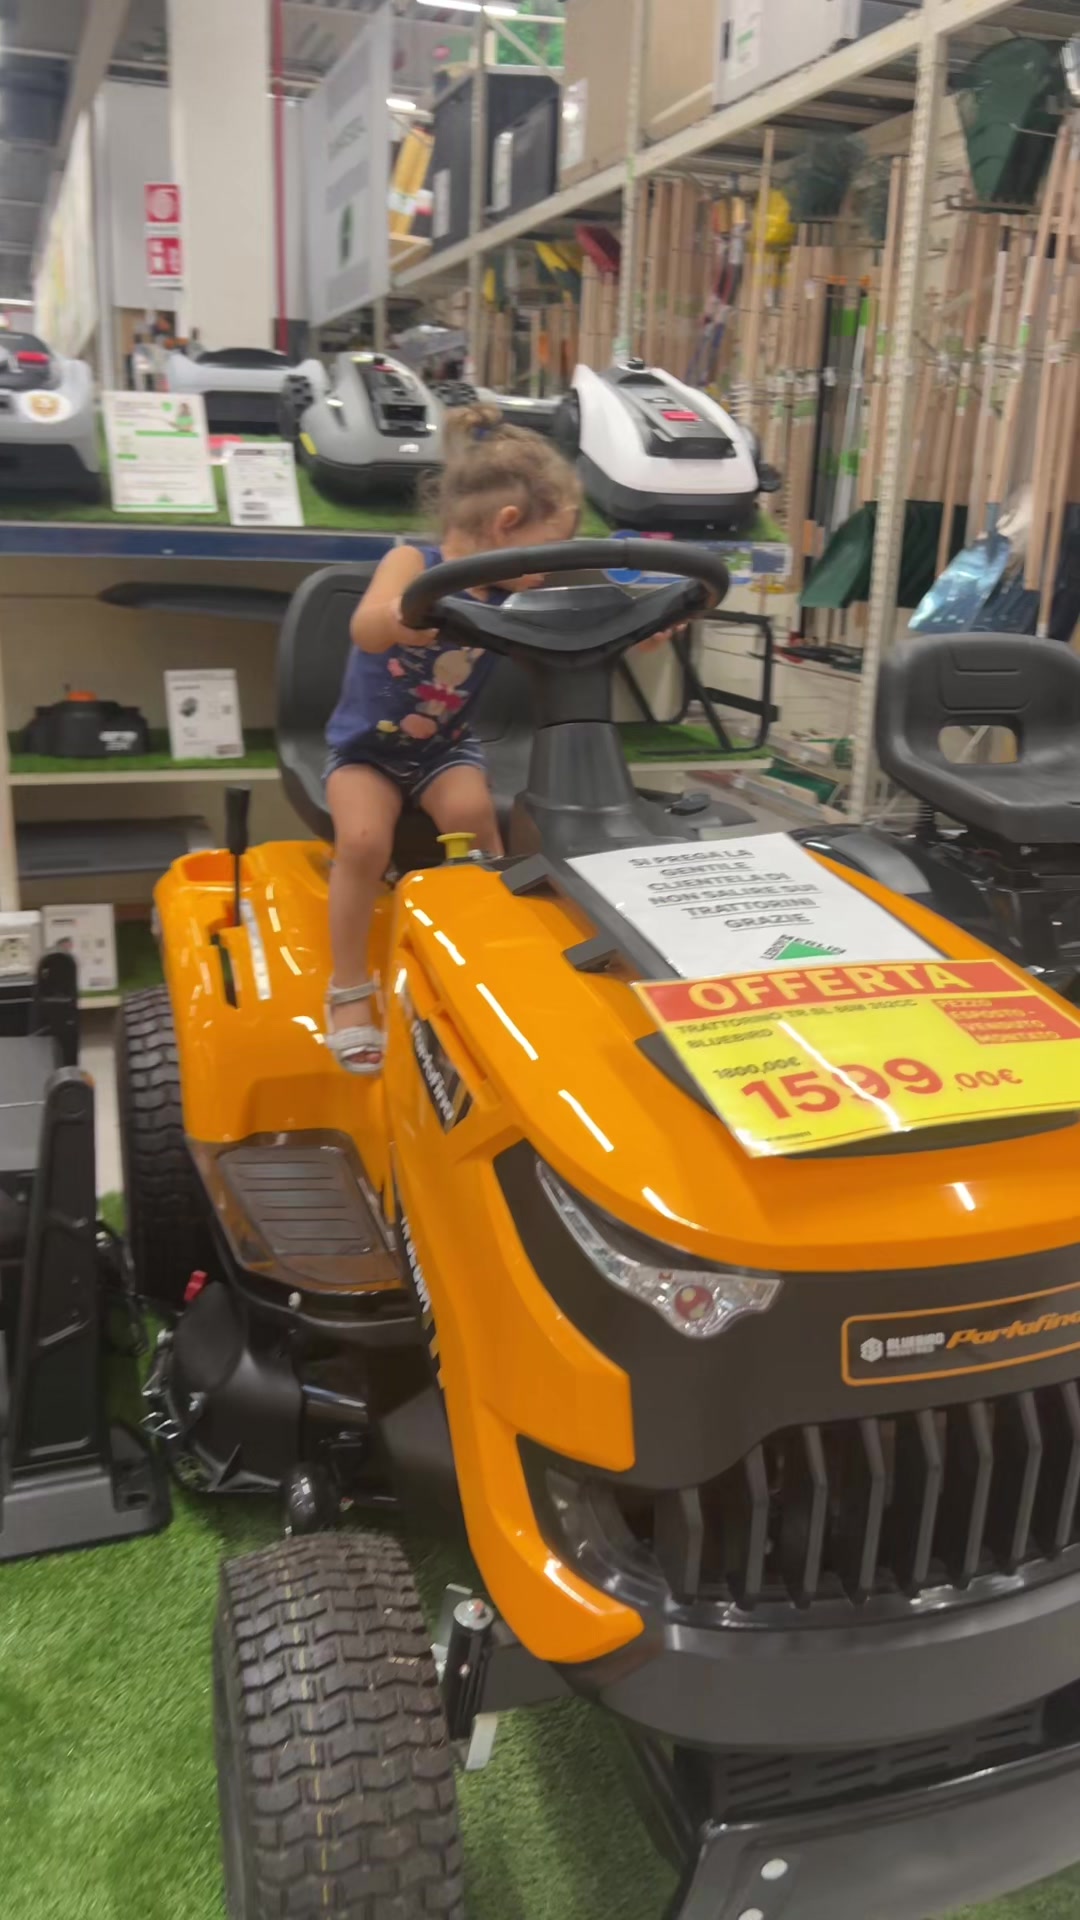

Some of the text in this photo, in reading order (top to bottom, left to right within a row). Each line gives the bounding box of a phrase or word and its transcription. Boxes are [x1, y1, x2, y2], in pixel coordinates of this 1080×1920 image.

[629, 849, 752, 867] SI PREGA LA
[660, 861, 750, 876] GENTILE
[647, 872, 791, 891] CLIENTELA DI
[648, 884, 818, 905] NON SALIRE SUI
[681, 897, 817, 916] TRATTORINI
[724, 912, 810, 929] GRAZIE
[688, 963, 974, 1011] OFFERTA
[713, 1056, 801, 1079] 1800,00€
[741, 1058, 943, 1120] 1599
